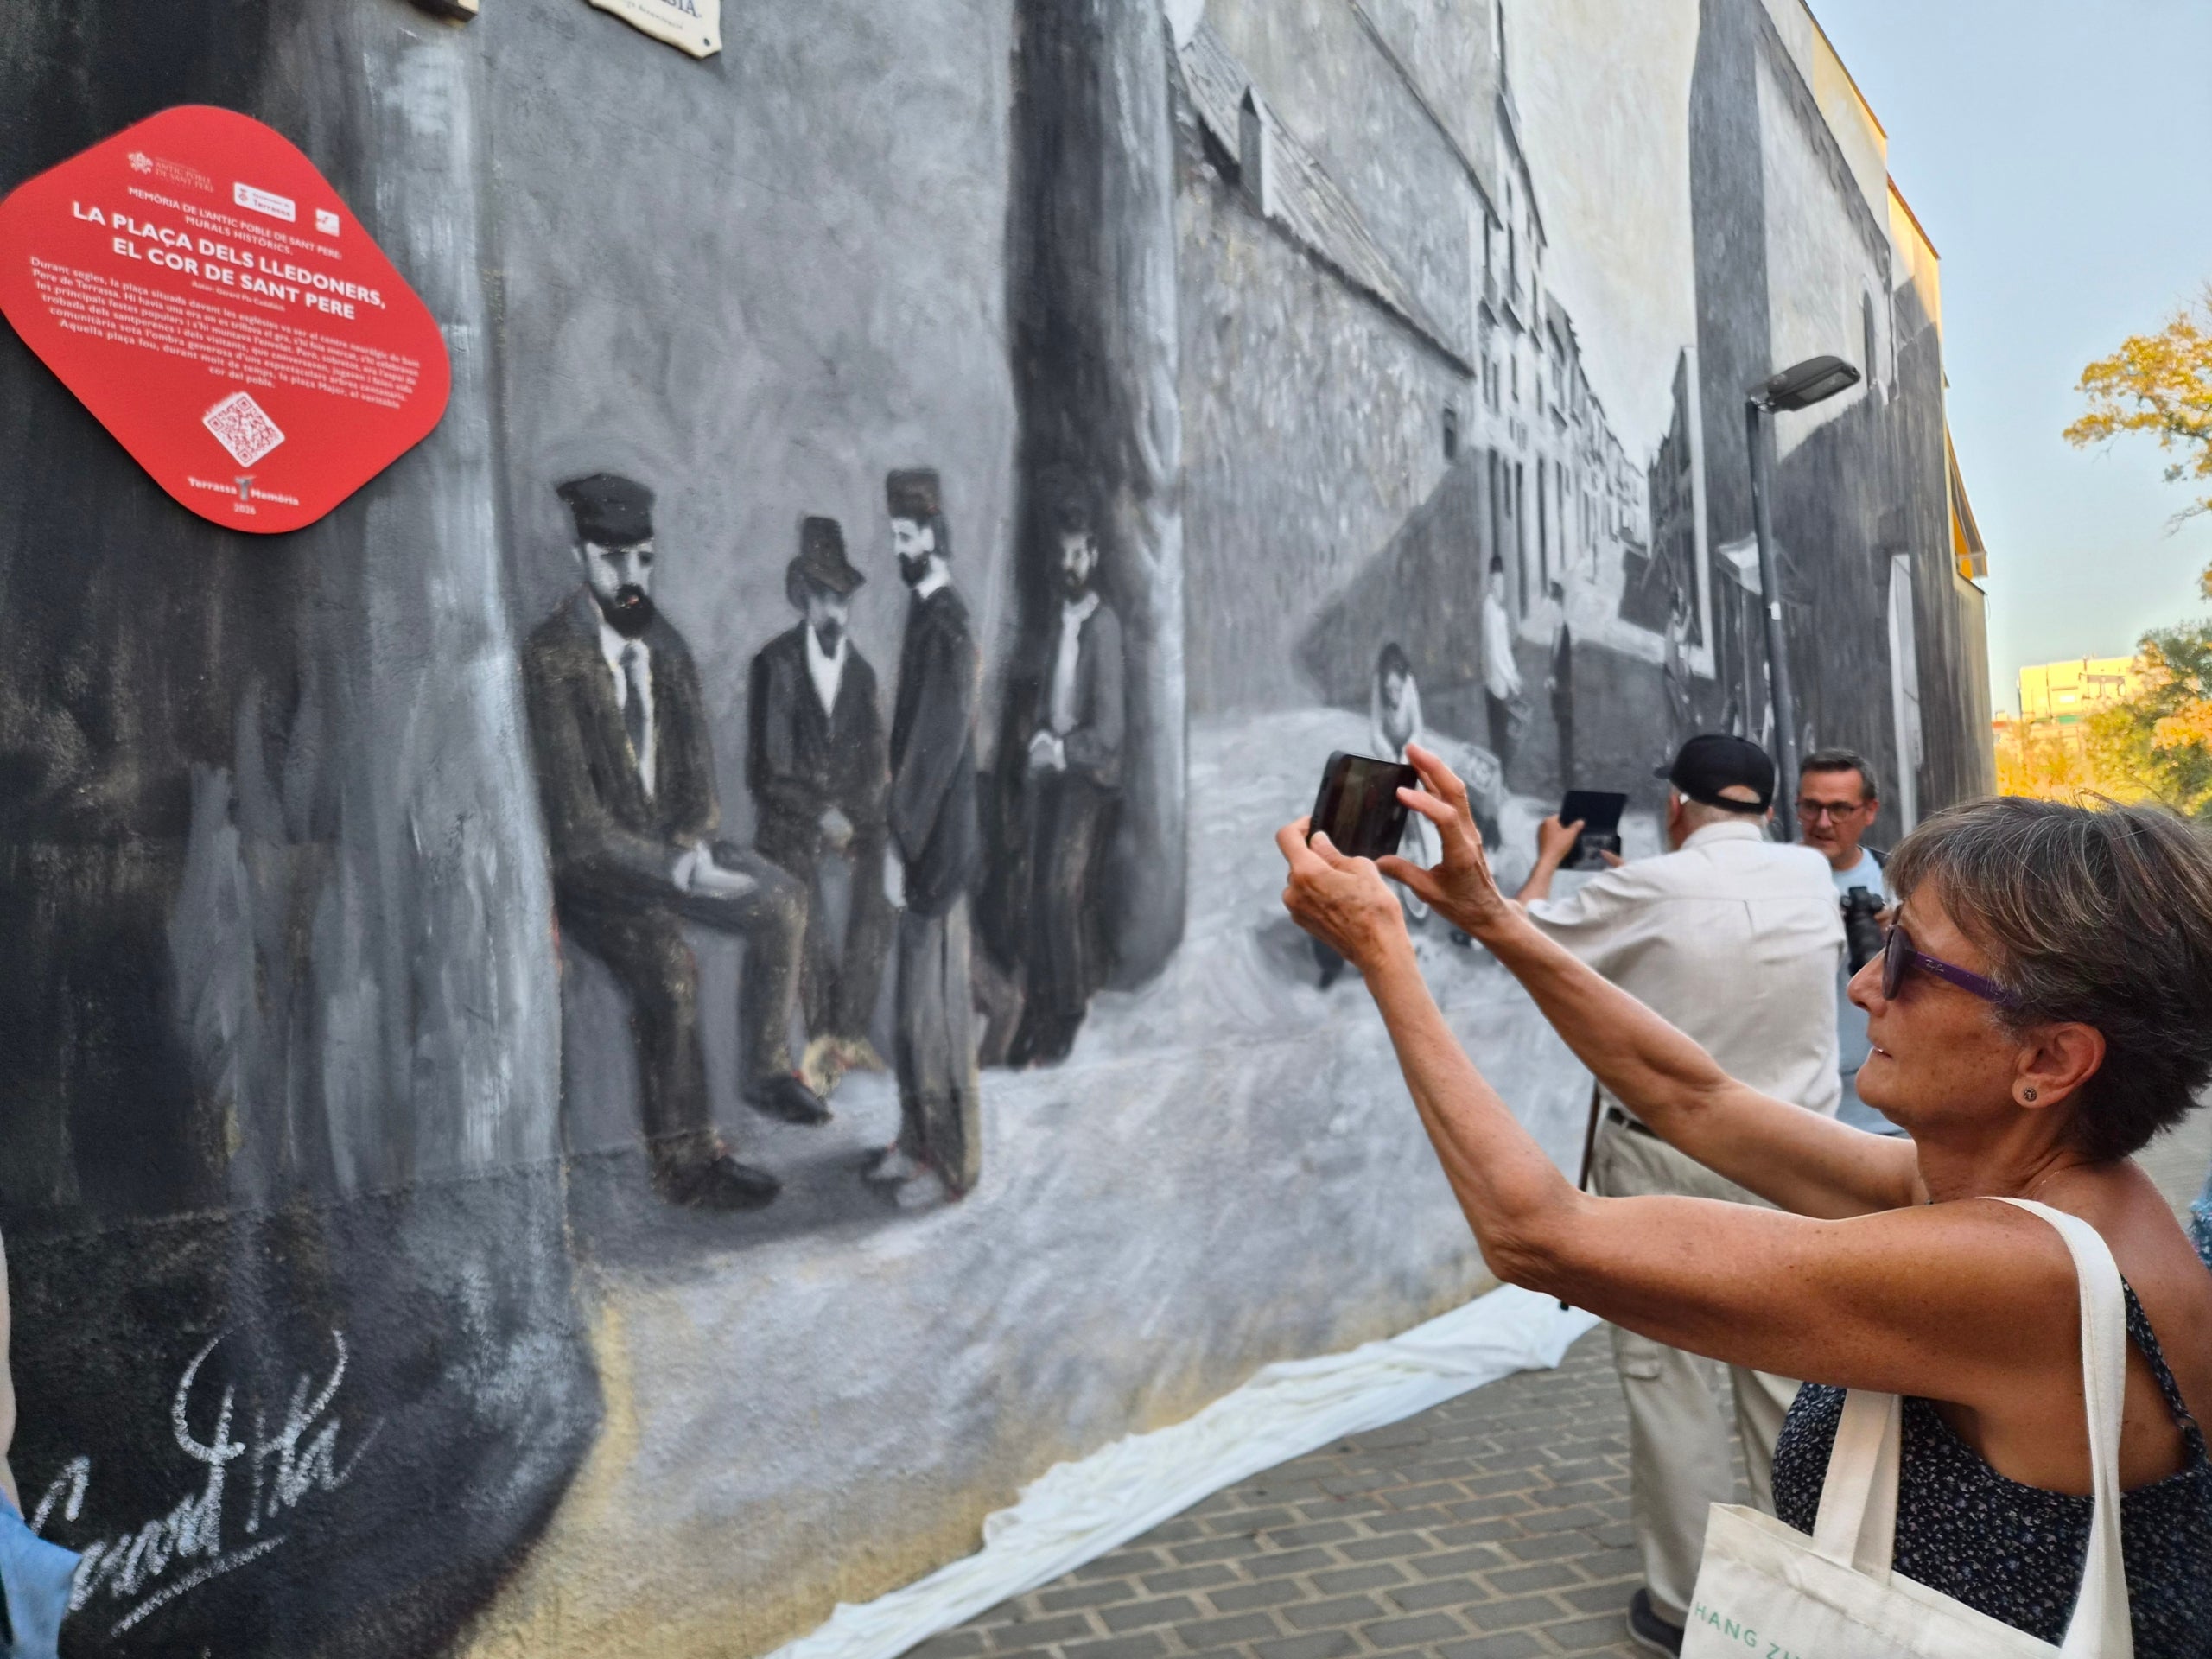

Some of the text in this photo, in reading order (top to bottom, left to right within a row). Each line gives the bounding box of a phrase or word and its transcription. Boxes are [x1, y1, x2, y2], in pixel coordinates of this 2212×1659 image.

[128, 187, 180, 208] MEMÒRIA
[182, 203, 196, 214] DE
[240, 221, 271, 238] POBLE
[273, 232, 287, 242] DE
[289, 237, 314, 251] SANT
[185, 215, 230, 236] MURALS
[73, 201, 385, 308] LA PLAÇA DELS LLEDONERS,
[112, 237, 354, 319] EL COR DE SANT PERE
[188, 476, 237, 494] Terrassa
